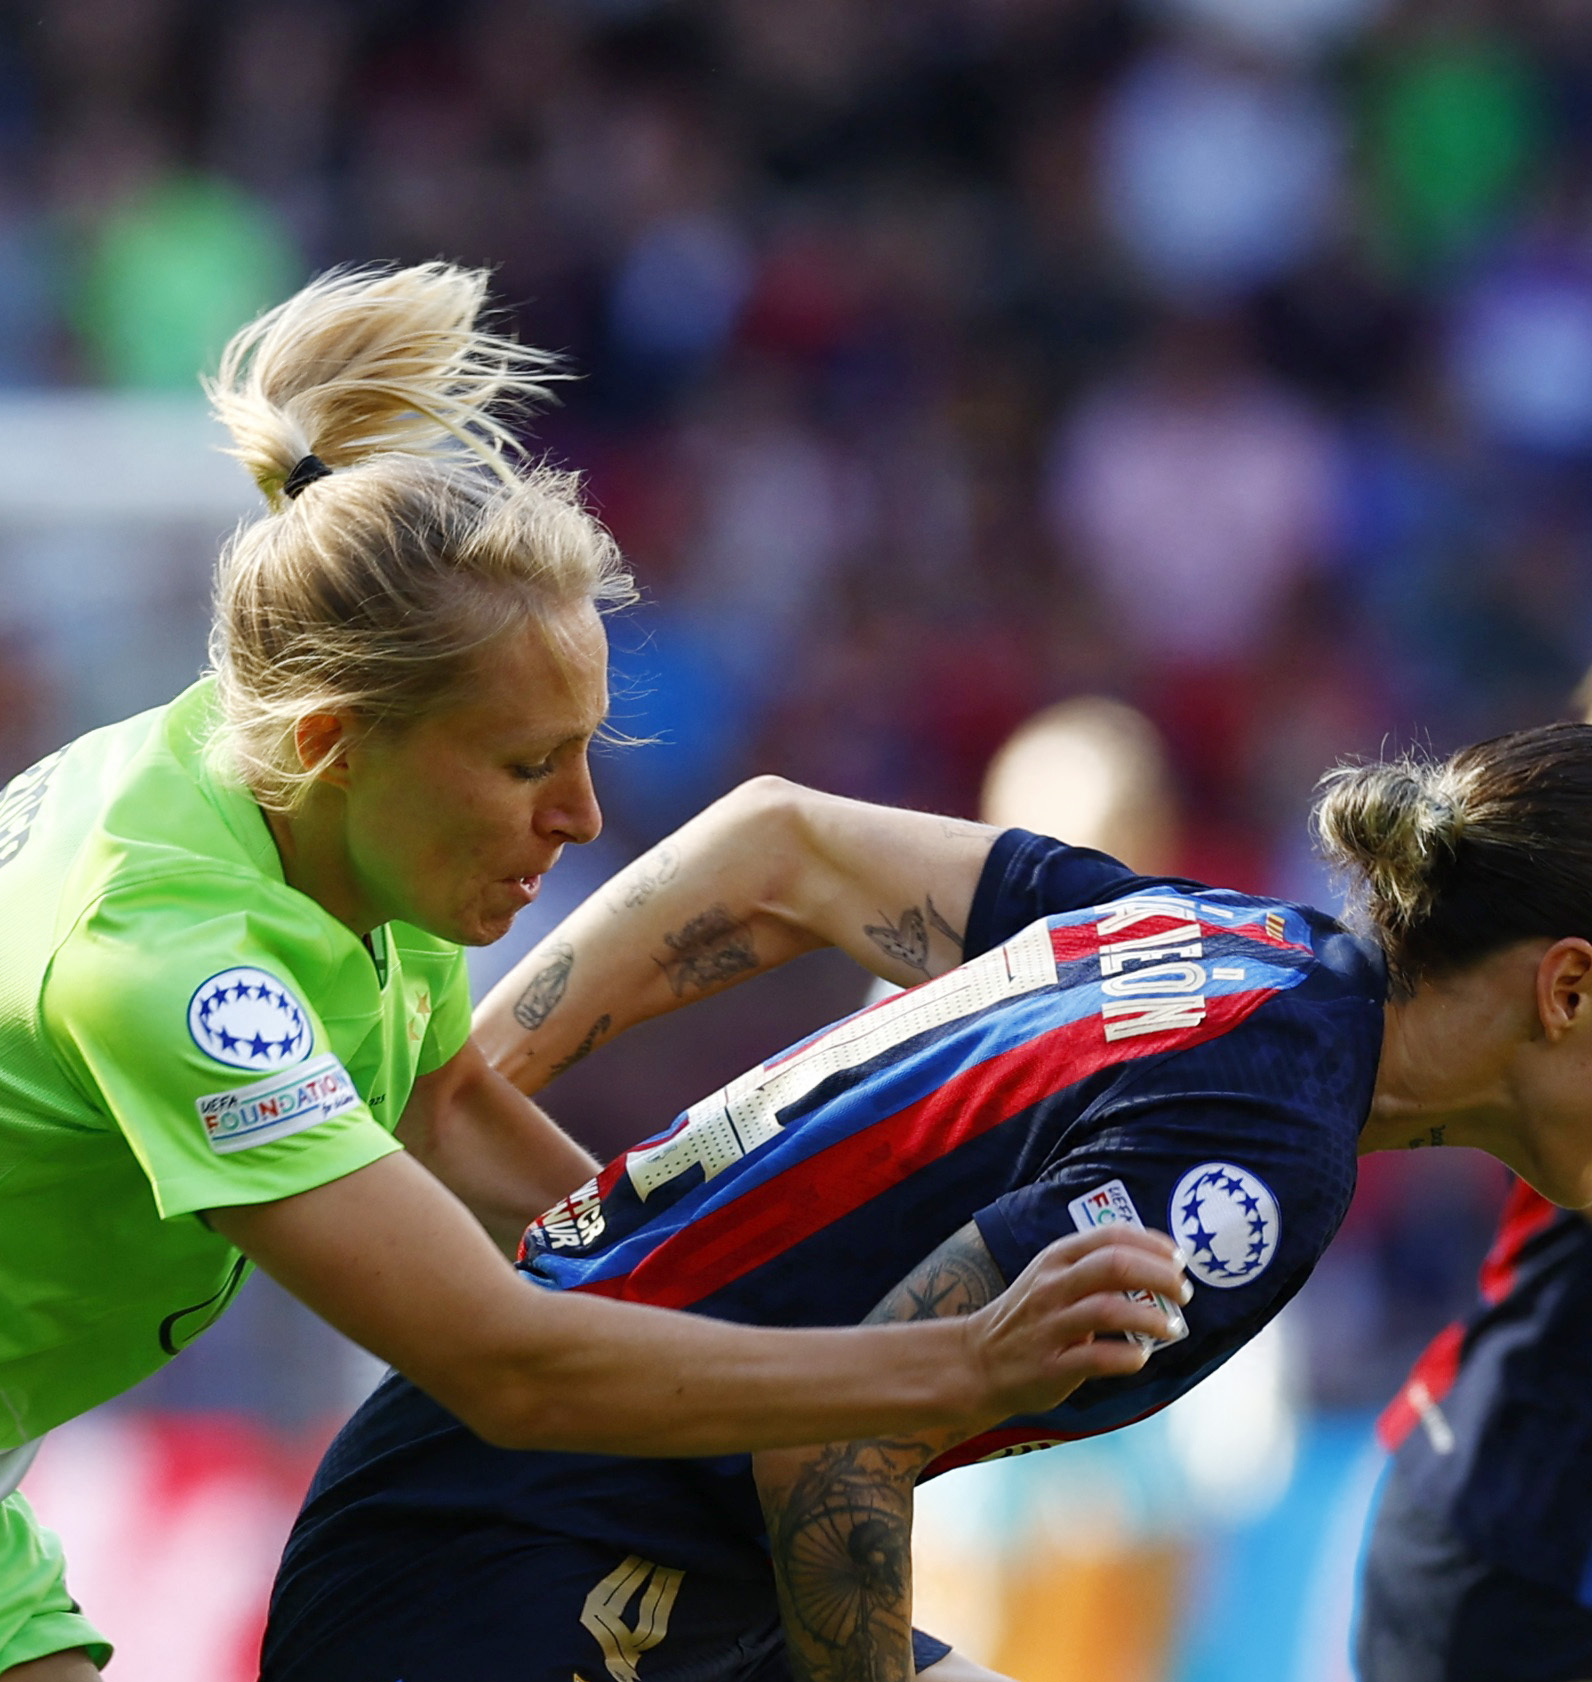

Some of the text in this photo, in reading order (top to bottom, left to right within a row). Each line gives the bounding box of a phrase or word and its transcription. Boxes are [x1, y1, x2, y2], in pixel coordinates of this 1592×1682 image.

[200, 1094, 239, 1114] UEFA
[204, 1071, 349, 1134] FOUNDATION
[569, 1176, 606, 1246] NHCR
[1108, 1186, 1135, 1223] UEFA
